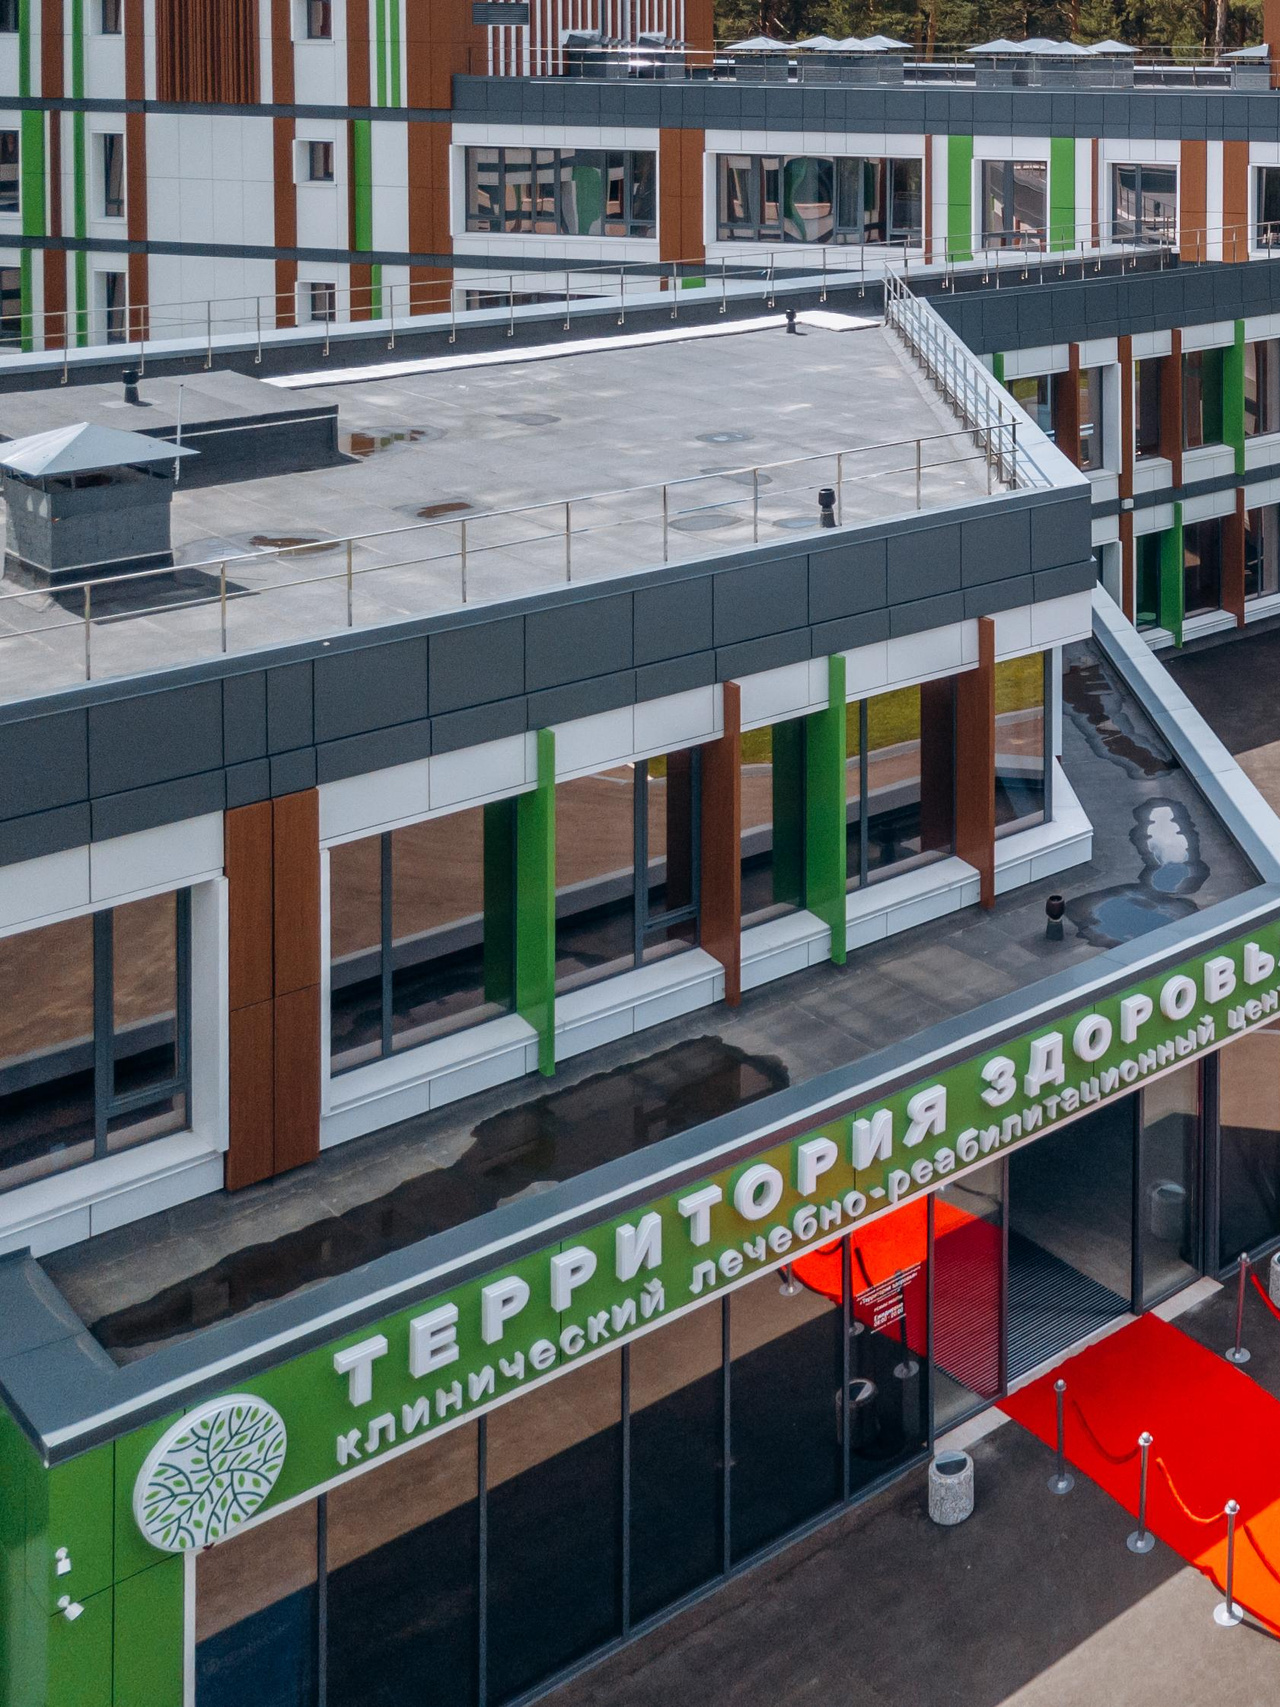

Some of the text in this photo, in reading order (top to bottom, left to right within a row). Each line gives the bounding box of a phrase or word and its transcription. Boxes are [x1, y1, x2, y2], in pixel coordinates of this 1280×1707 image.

[333, 1084, 947, 1407] ТЕРРИТОРИЯ
[336, 1278, 665, 1466] клинический
[689, 1015, 1215, 1294] лечебно-реабилитационный
